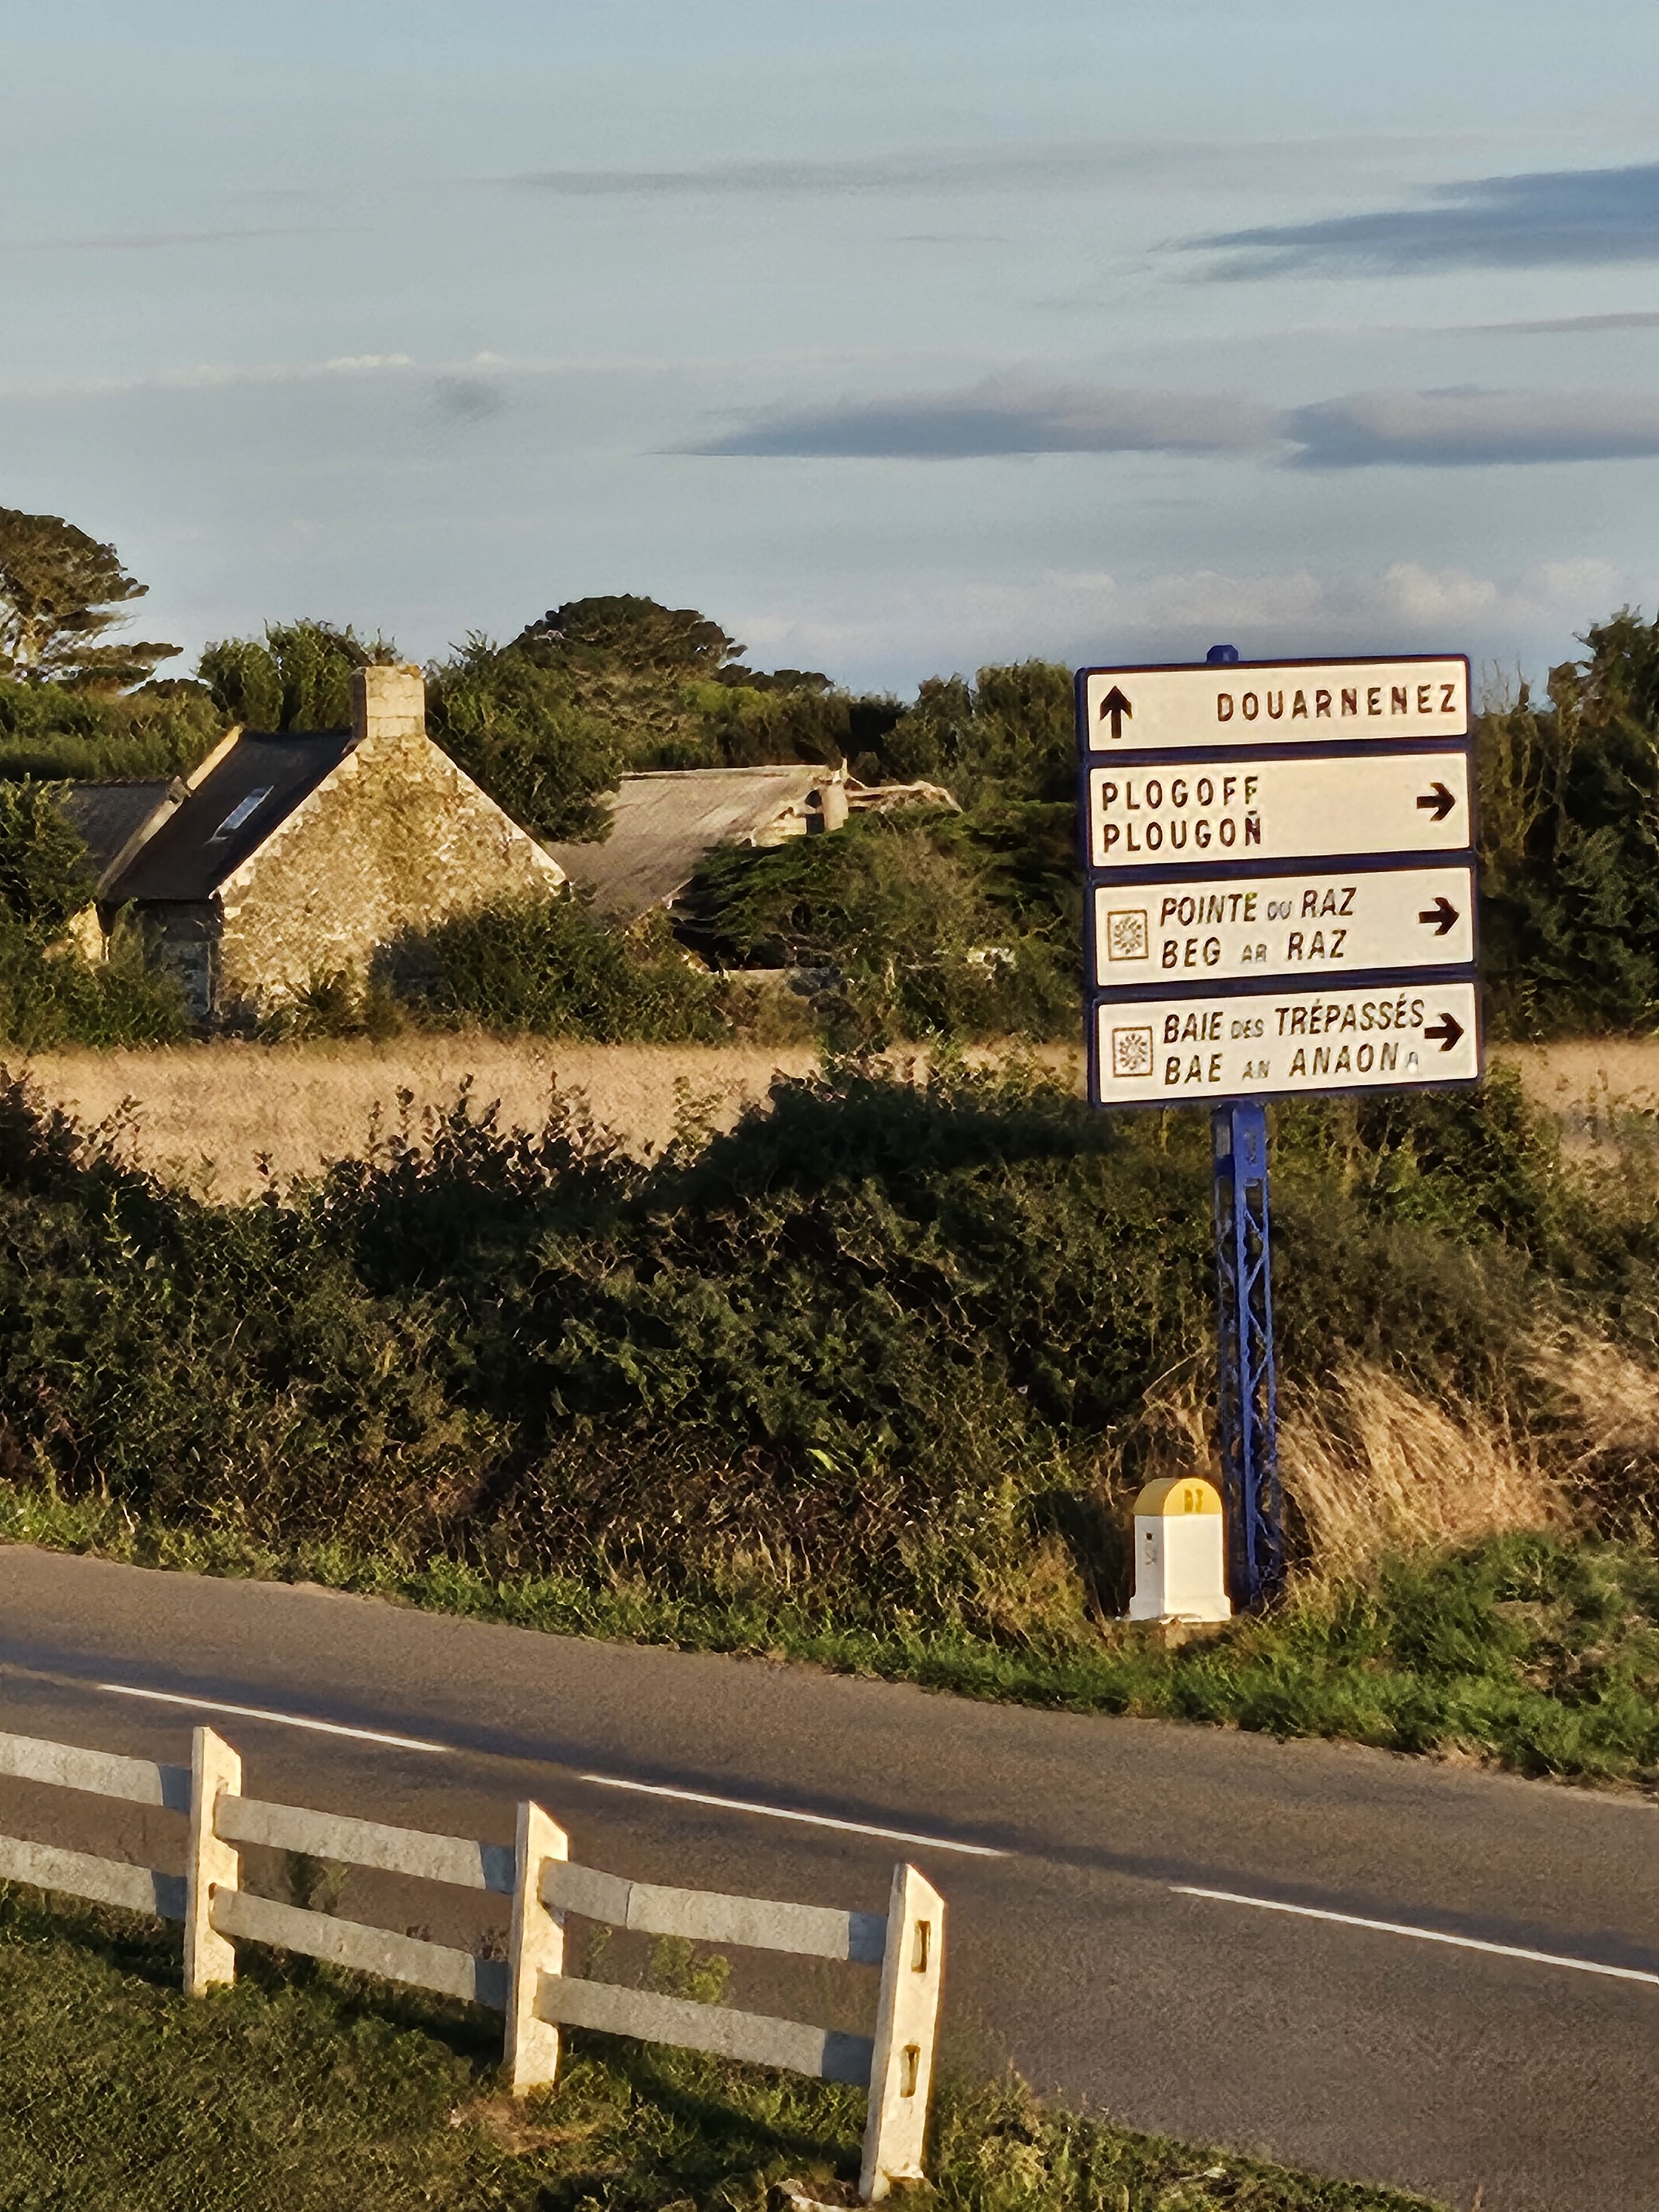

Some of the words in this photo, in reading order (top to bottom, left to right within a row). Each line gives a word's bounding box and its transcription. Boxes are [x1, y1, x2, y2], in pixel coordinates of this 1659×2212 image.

[1217, 684, 1456, 722] DOUARNENEZ
[1102, 777, 1259, 811] PLOGOFF
[1103, 810, 1261, 853] PLOUGOÑ
[1160, 892, 1258, 927] POINTE
[1267, 900, 1292, 921] DU
[1301, 887, 1357, 918] RAZ
[1161, 937, 1221, 969] BEG
[1287, 930, 1347, 961] RAZ
[1164, 1011, 1224, 1044] BAIE
[1230, 1018, 1264, 1039] DES
[1275, 993, 1425, 1036] TRÉPASSÉS
[1165, 1053, 1223, 1085] BAE
[1289, 1042, 1399, 1077] ANAON
